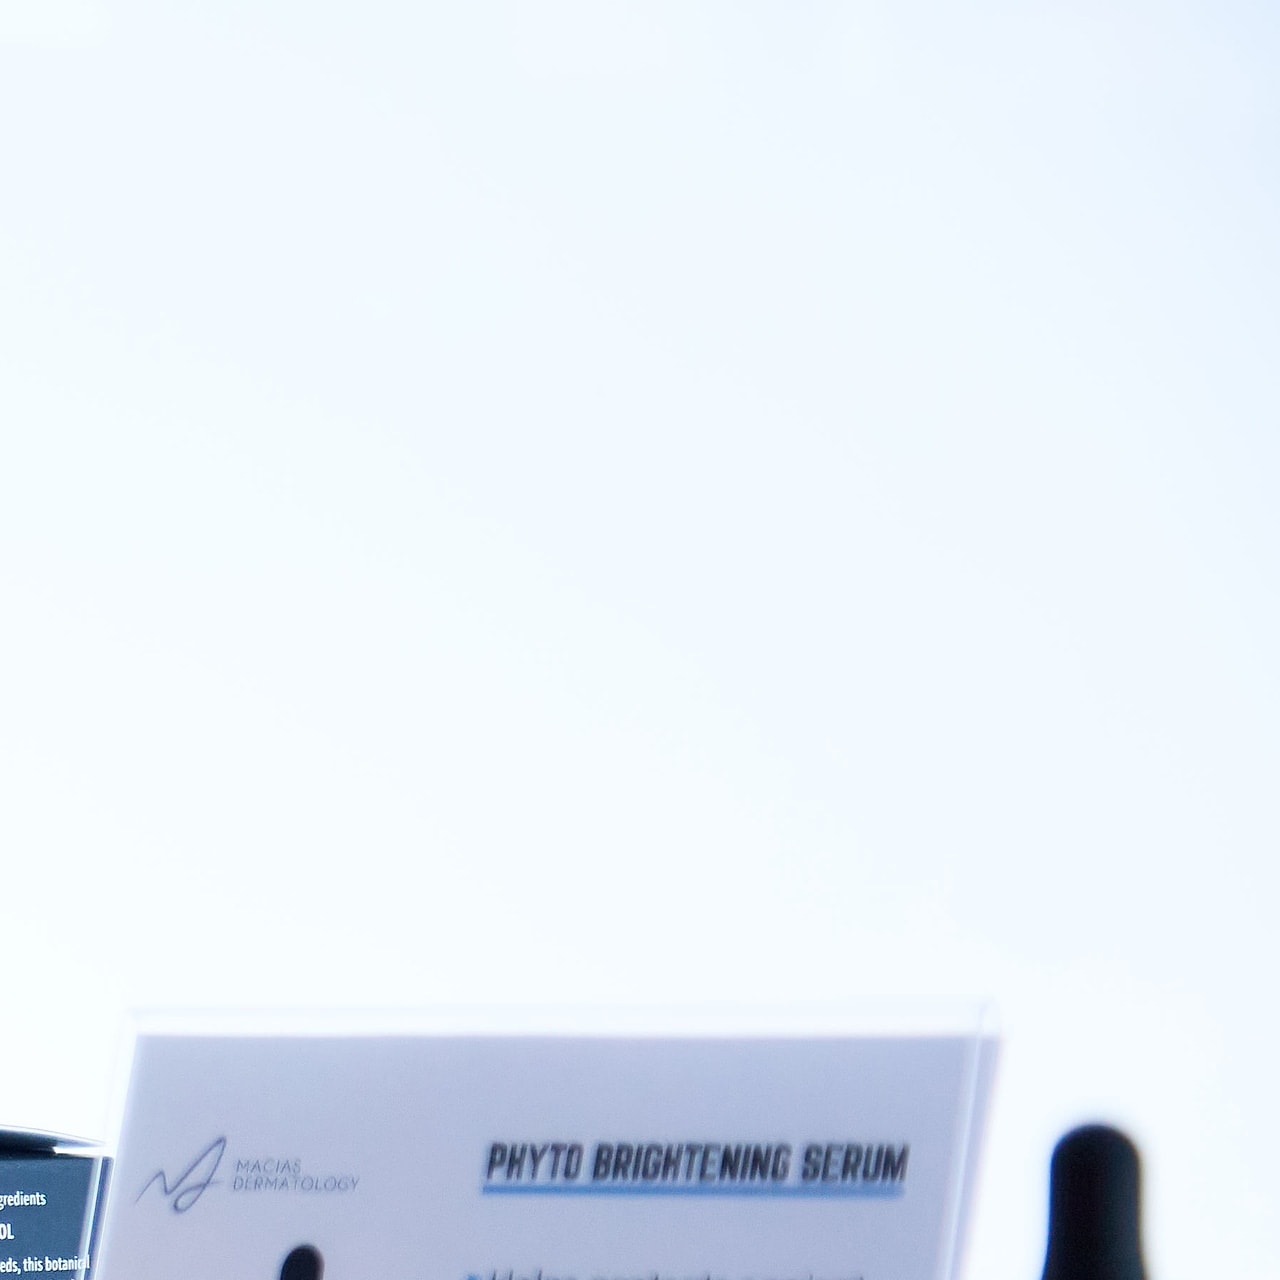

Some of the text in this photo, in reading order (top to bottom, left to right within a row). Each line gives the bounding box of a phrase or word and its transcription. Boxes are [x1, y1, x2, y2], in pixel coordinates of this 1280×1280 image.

[236, 1159, 301, 1174] MACIAS
[486, 1141, 911, 1185] PHYTO BRIGHTENING SERUM
[232, 1175, 360, 1192] DERMATOLOGY
[23, 1257, 43, 1272] this
